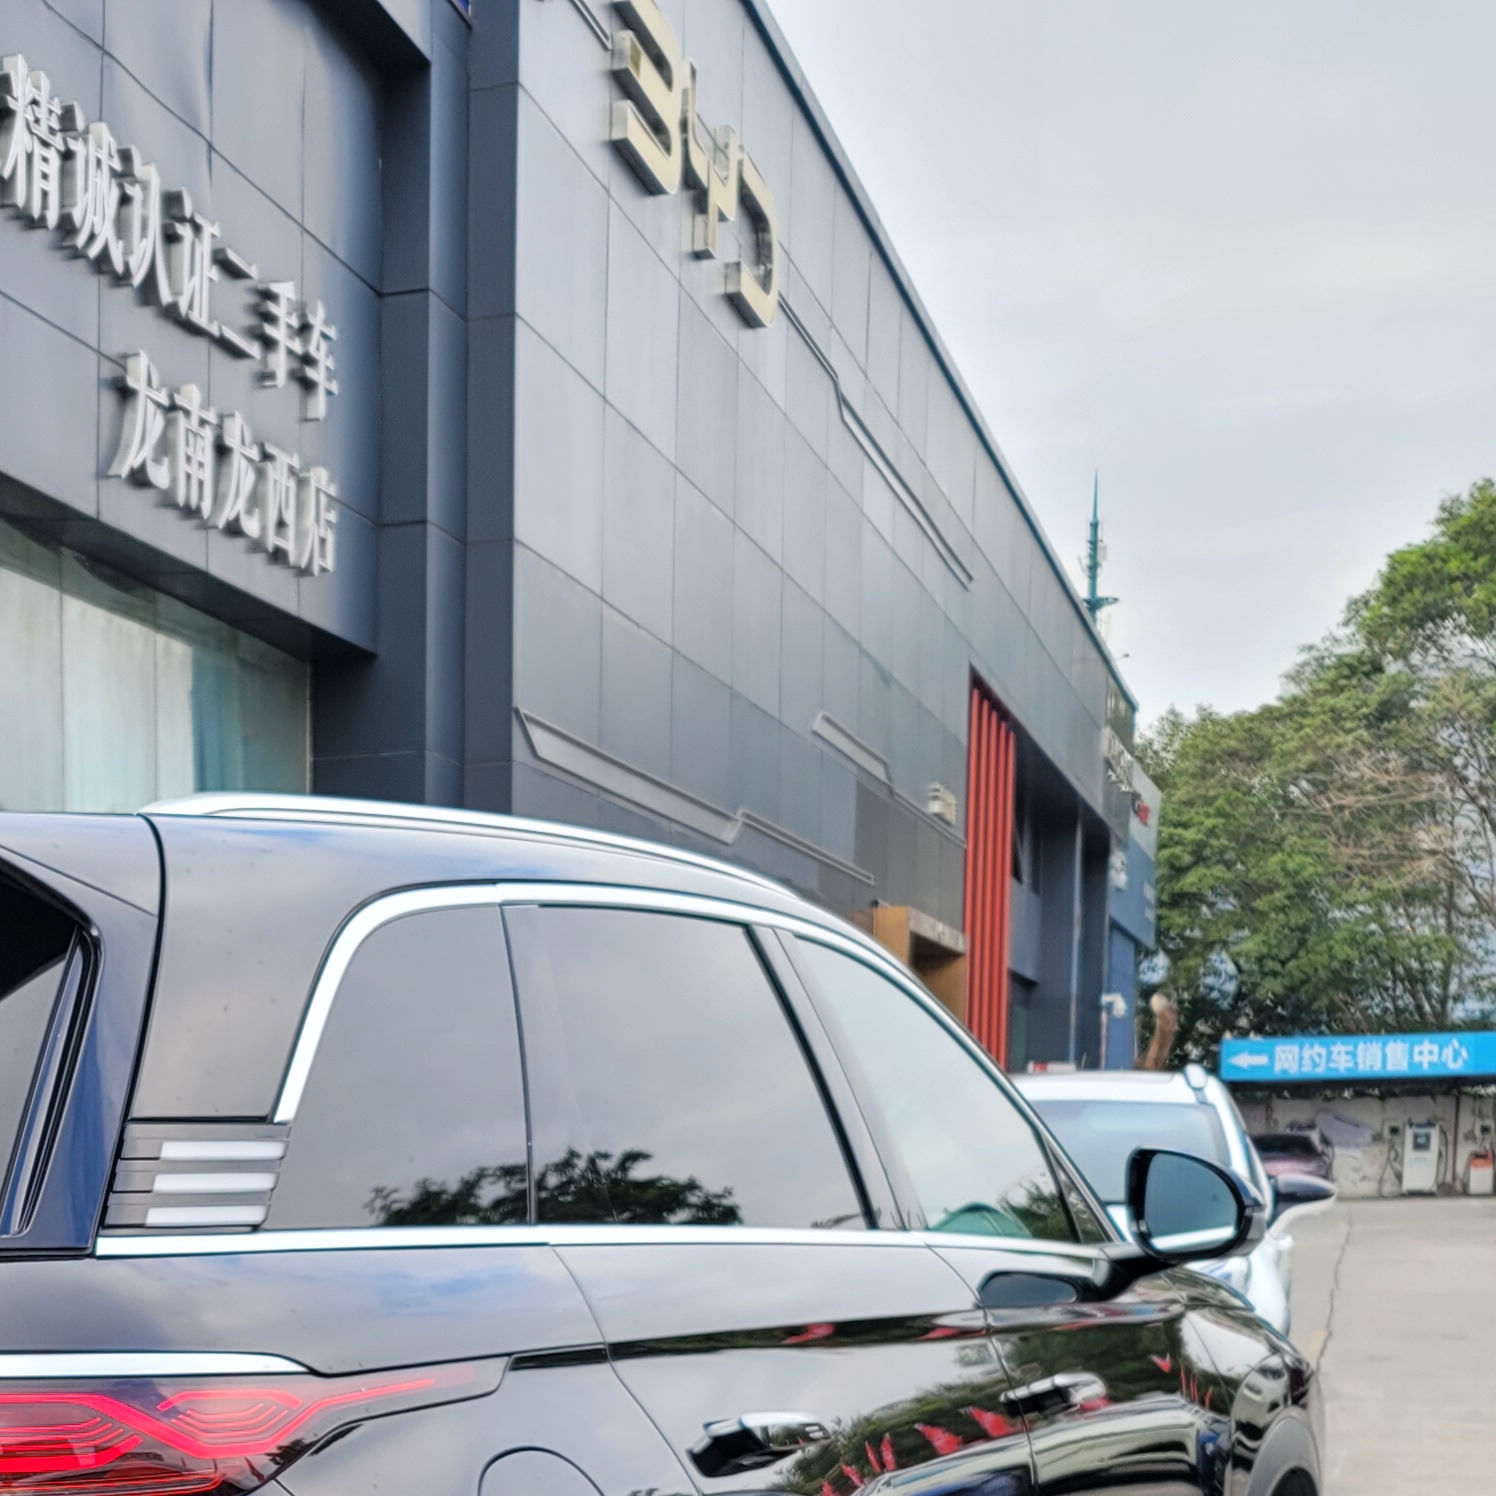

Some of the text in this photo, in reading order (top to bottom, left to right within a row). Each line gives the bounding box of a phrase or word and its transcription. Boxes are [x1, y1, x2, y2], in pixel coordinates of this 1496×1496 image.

[609, 0, 778, 328] BYD
[109, 349, 336, 576] 龙南龙西店
[1273, 1038, 1469, 1075] 网约车销售中心
